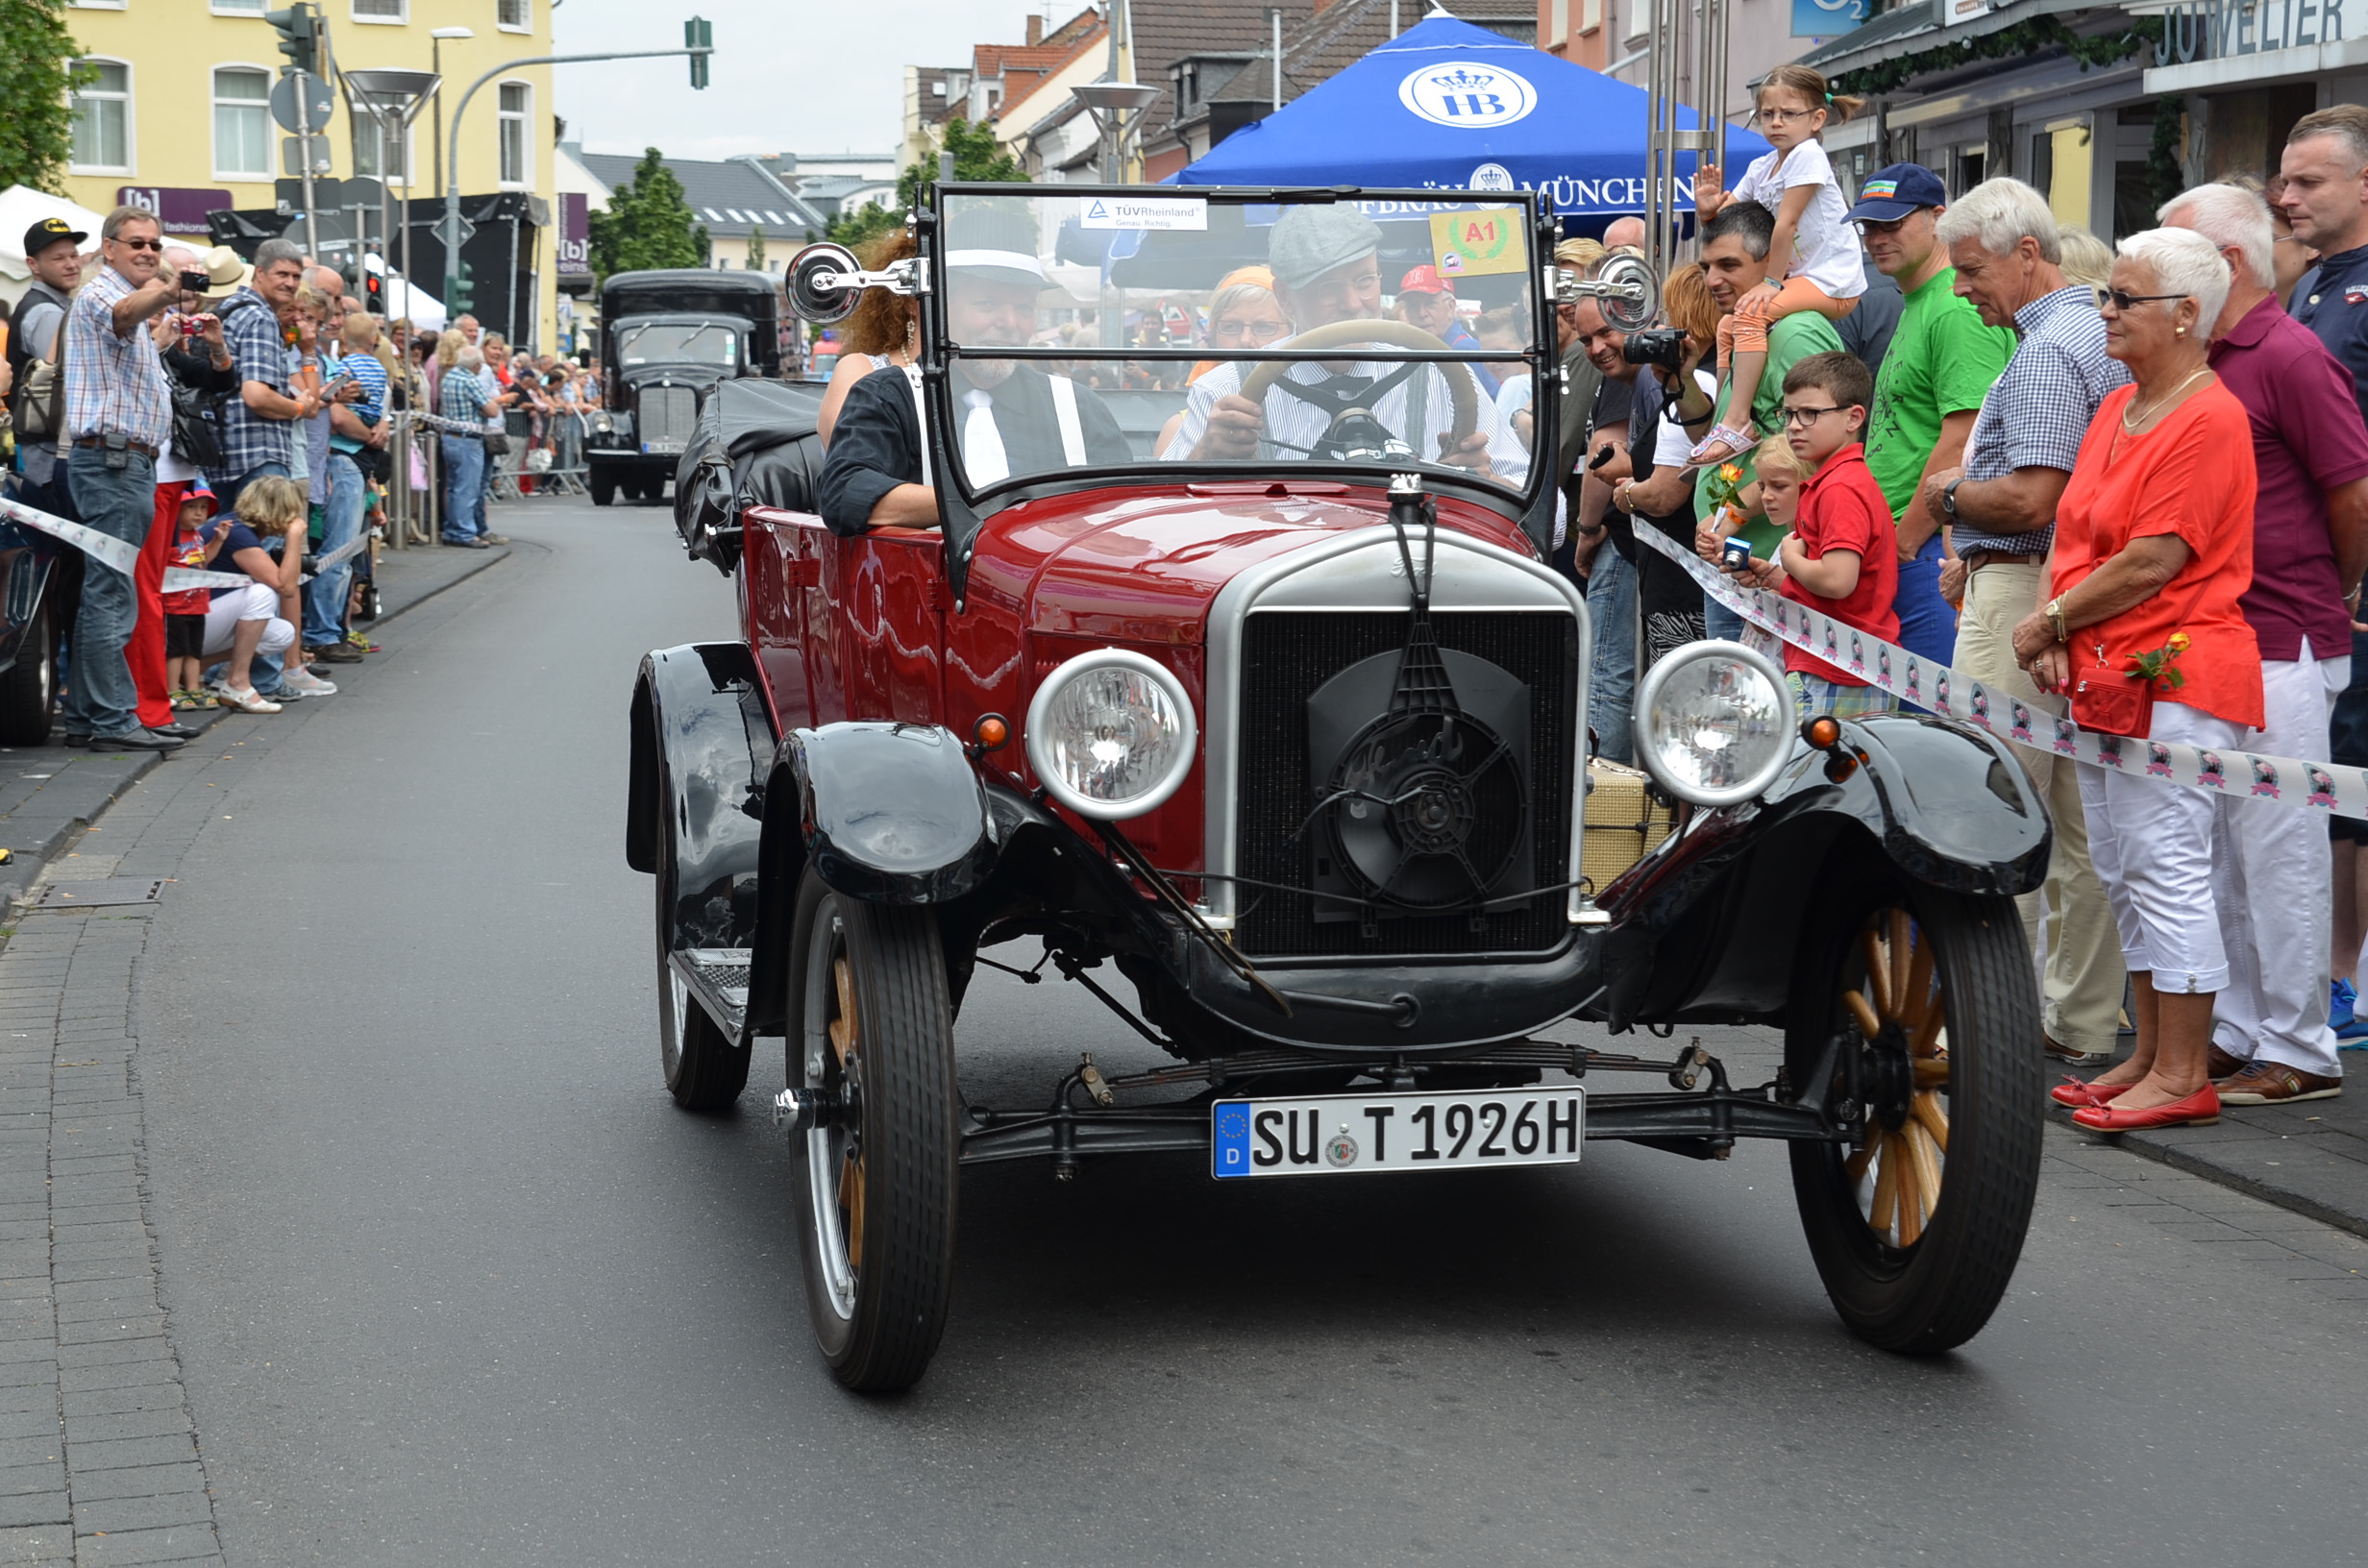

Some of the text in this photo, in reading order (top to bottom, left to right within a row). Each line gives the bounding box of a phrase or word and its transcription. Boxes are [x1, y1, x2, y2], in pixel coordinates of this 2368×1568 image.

[2155, 0, 2342, 67] JUWELIER
[1441, 93, 1506, 116] HB
[1521, 175, 1695, 207] MÜNCHN
[1466, 221, 1495, 242] A1
[1252, 1107, 1320, 1166] SU
[1411, 1098, 1578, 1160] 1926H
[1226, 1148, 1240, 1164] D
